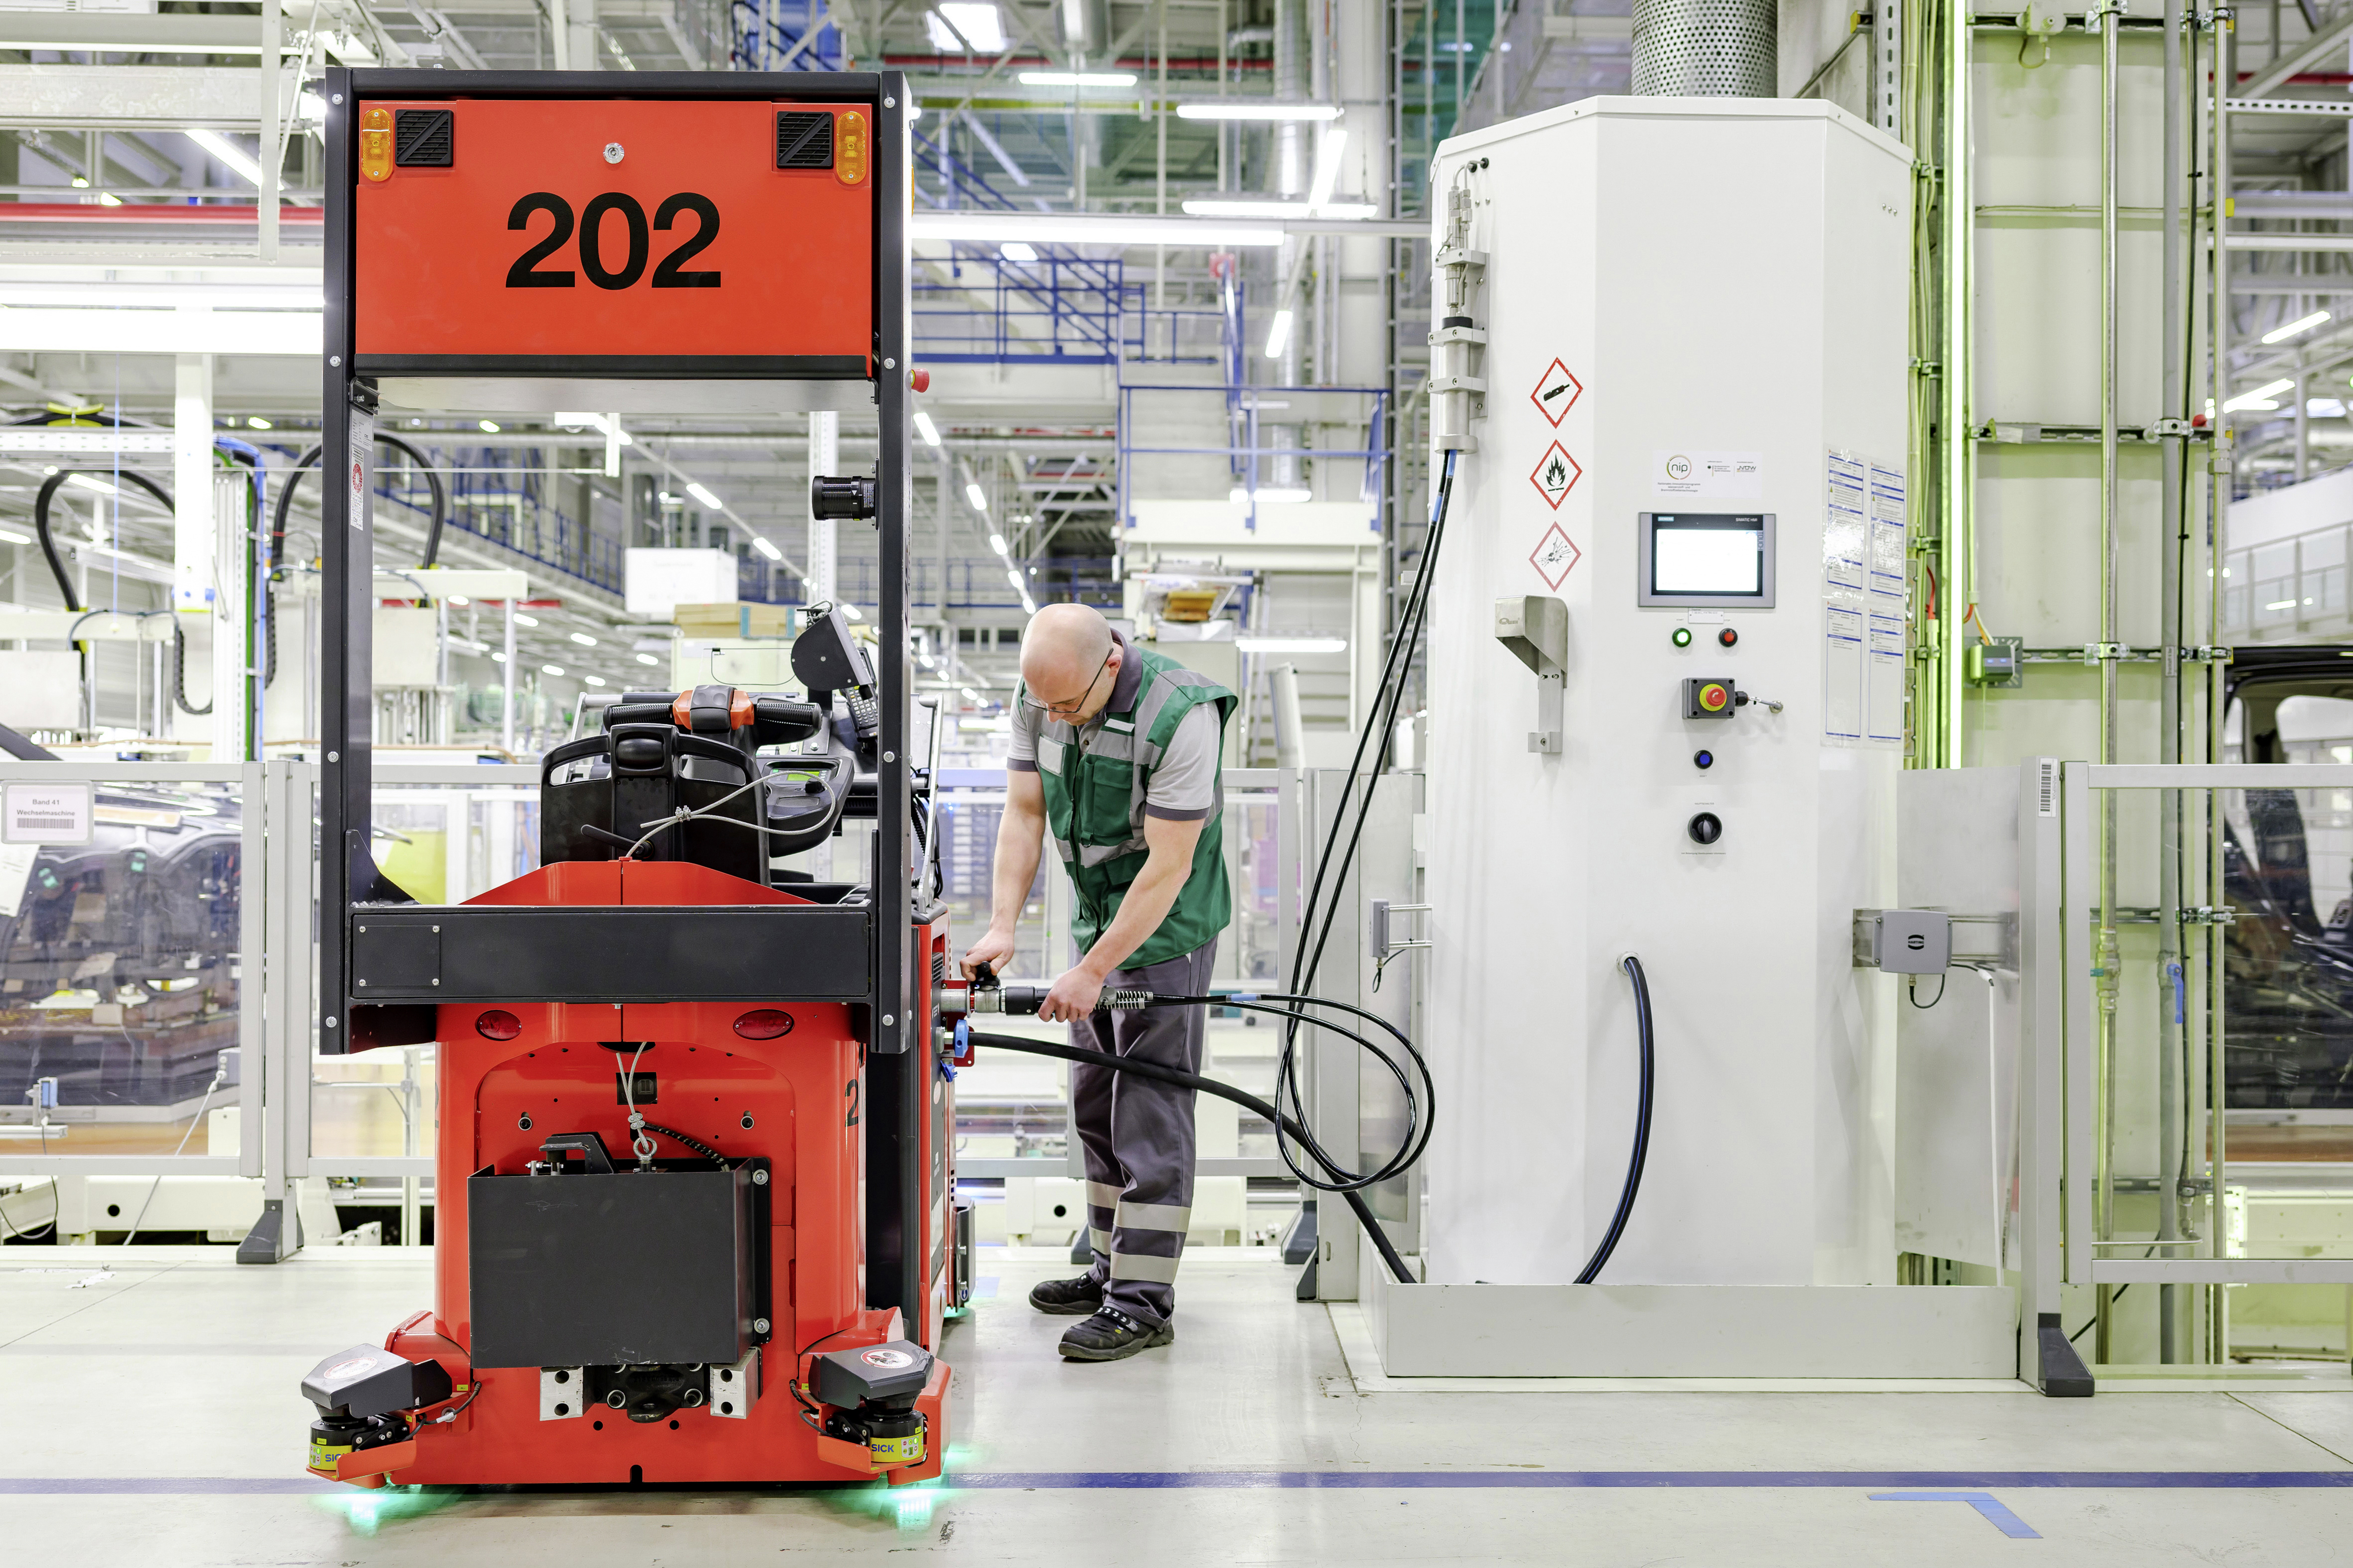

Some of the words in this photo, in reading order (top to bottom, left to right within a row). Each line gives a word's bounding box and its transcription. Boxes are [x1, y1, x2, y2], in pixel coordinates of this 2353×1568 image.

[505, 192, 721, 290] 202
[1672, 462, 1688, 473] nip
[871, 1444, 894, 1453] SICK
[325, 1453, 345, 1462] SIC
